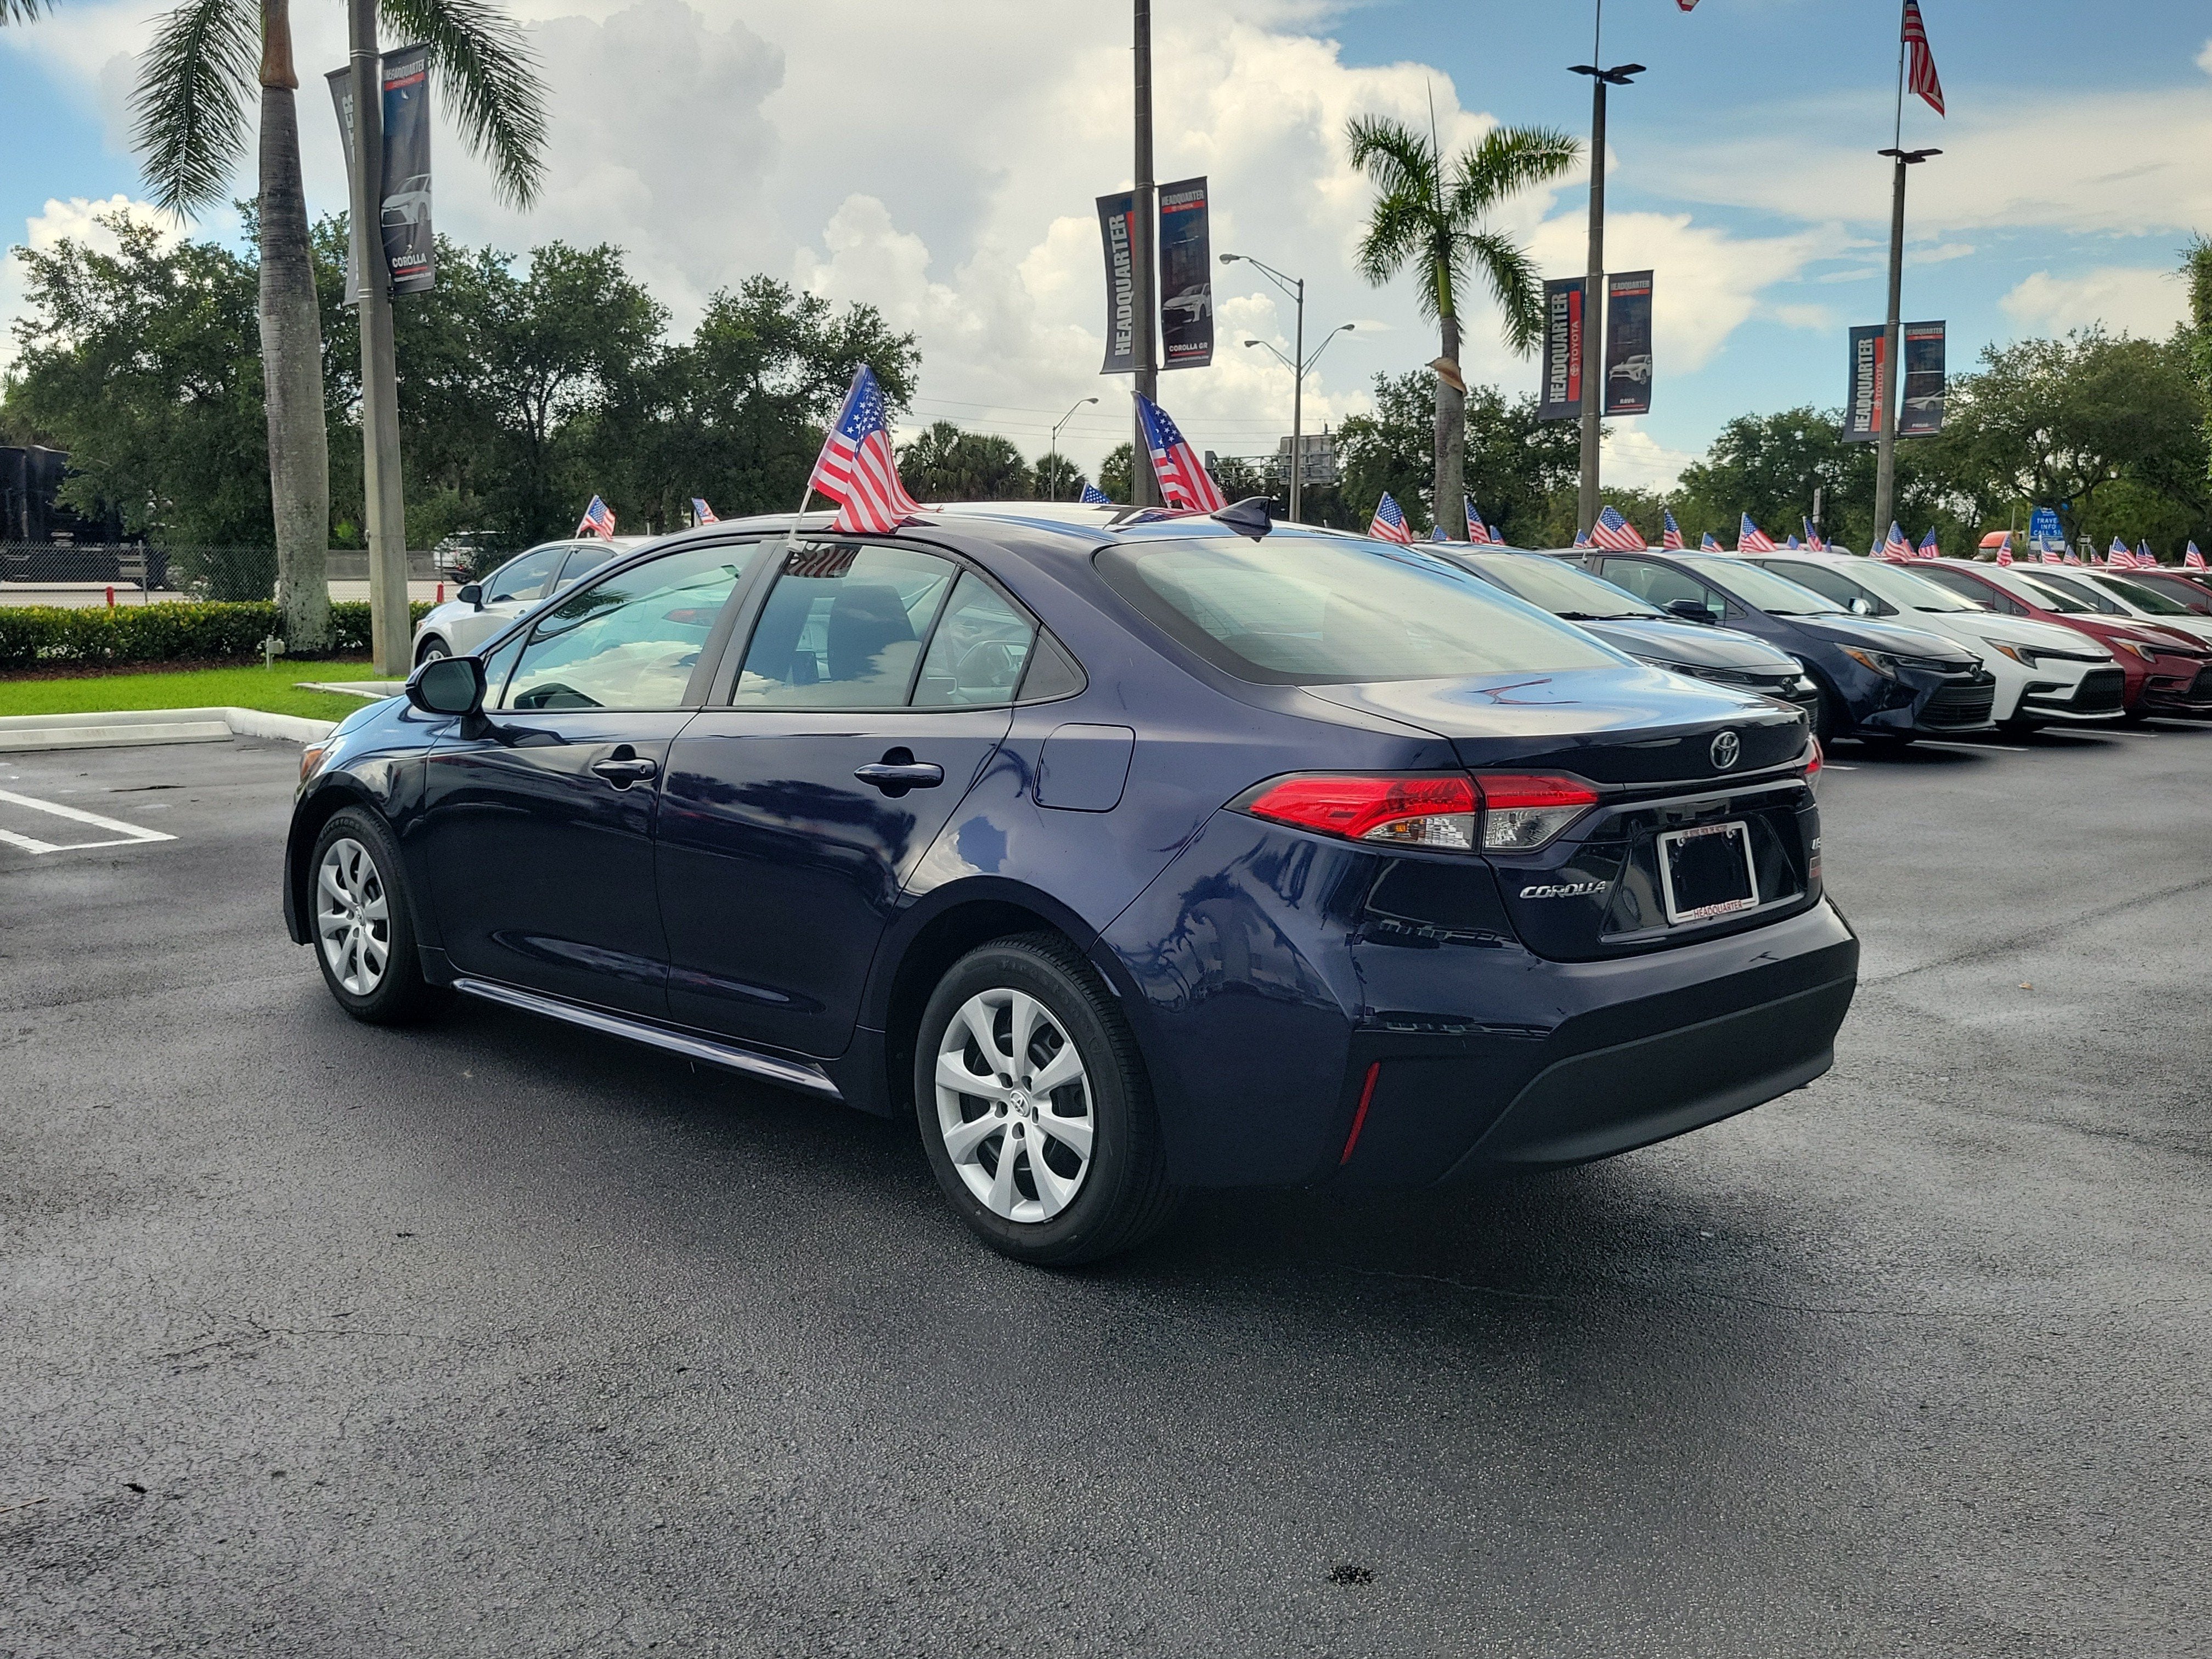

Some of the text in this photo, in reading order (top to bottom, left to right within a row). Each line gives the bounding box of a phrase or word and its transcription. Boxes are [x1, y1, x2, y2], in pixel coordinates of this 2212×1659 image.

[392, 253, 427, 268] COROLLA
[1108, 214, 1134, 356] HEADQUARTER
[1169, 343, 1198, 352] COROLLA
[1549, 292, 1569, 403] HEADQUARTER
[1853, 338, 1874, 432] HEADQUARTER
[1520, 881, 1606, 899] COROLLA
[1693, 900, 1743, 918] HEADQUARTER
